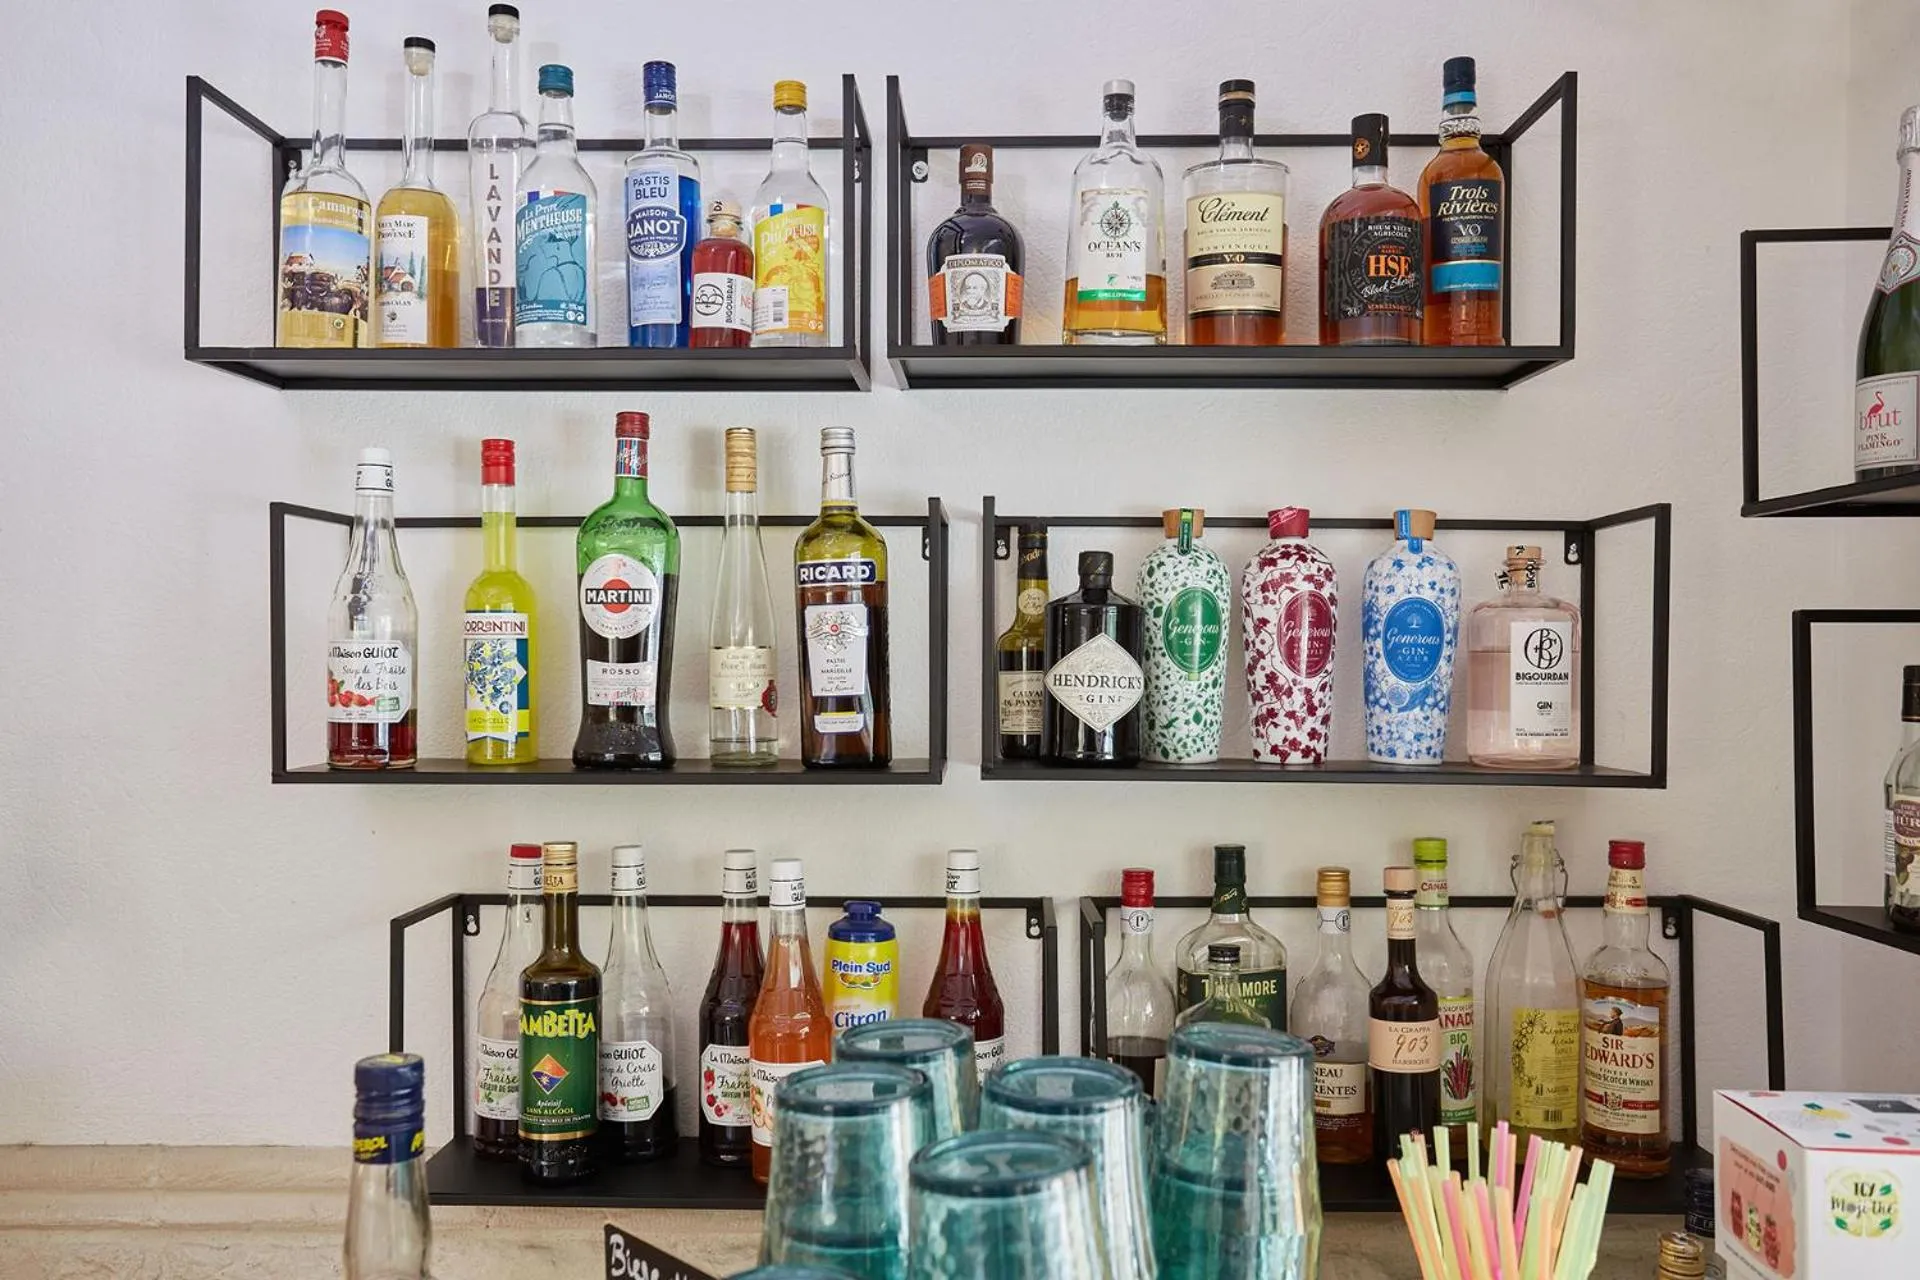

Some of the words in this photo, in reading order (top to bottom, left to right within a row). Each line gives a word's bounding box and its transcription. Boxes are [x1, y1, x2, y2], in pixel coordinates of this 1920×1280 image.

[633, 175, 670, 188] PASTIS
[635, 187, 668, 200] BLEU
[1449, 185, 1489, 201] Trois
[635, 209, 668, 219] MAISON
[1197, 197, 1270, 224] Clément
[1437, 199, 1499, 217] Rivières
[487, 163, 502, 307] LAVANDE
[628, 219, 681, 239] JANOT
[1457, 222, 1482, 236] VO
[1088, 239, 1142, 253] OCEAN'S
[1368, 254, 1412, 279] HSE
[1860, 407, 1902, 431] brut
[1866, 432, 1888, 442] PINK
[800, 565, 871, 582] RICARD
[587, 589, 651, 604] MARTINI
[1168, 616, 1219, 640] Generous
[1184, 637, 1207, 646] GN
[1387, 626, 1441, 650] Generous
[1402, 647, 1425, 655] GIN
[601, 667, 640, 676] ROSSO
[1515, 672, 1569, 681] BIGOURDAN
[1052, 674, 1142, 690] HENDRICK'S
[1086, 695, 1116, 704] GIN
[1536, 701, 1552, 710] GIN
[832, 959, 863, 974] Plein
[866, 960, 891, 974] Sud
[1201, 979, 1278, 998] TMORE
[520, 1008, 597, 1039] AMBETTA
[834, 1008, 888, 1028] Citron
[1450, 1032, 1468, 1045] BIO
[1602, 1035, 1625, 1051] SIR
[1394, 1034, 1429, 1059] 903
[709, 1051, 719, 1063] La
[1585, 1042, 1655, 1070] EDWARD'S
[1313, 1067, 1344, 1078] NEAU
[1314, 1084, 1357, 1096] RENTES
